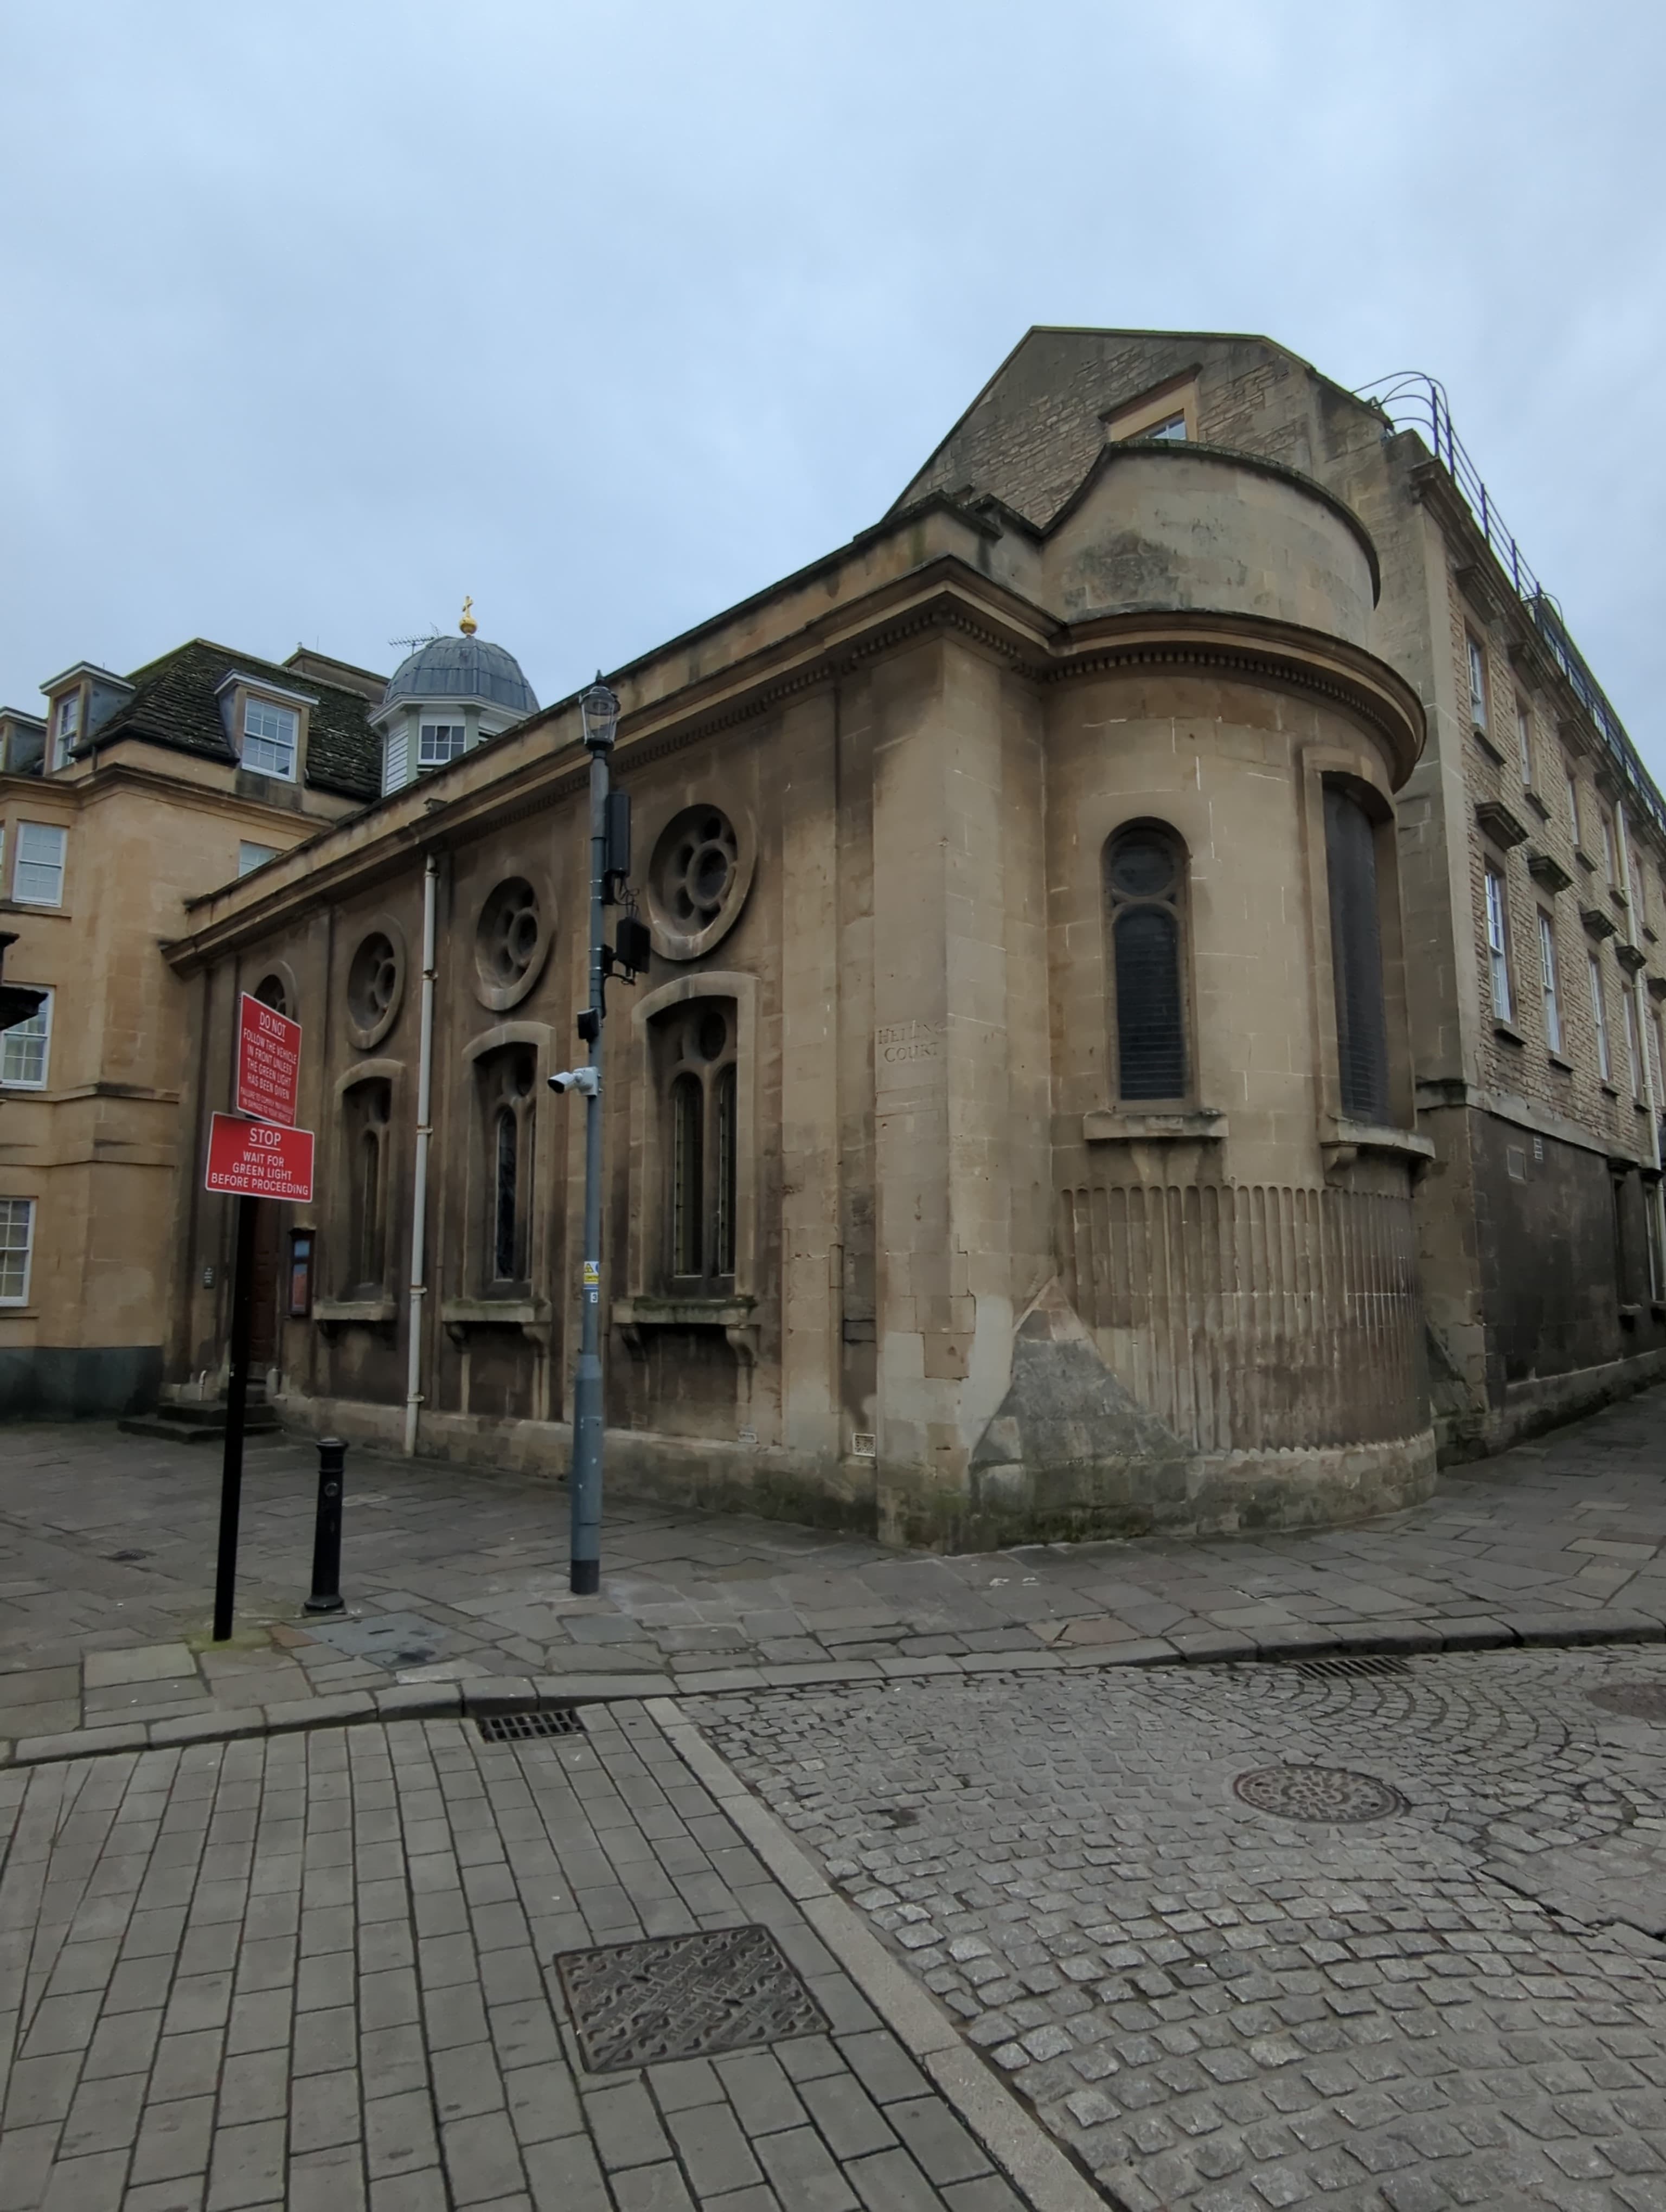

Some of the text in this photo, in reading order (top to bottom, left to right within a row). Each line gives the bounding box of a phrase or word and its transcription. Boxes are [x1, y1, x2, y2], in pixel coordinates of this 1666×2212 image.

[260, 1012, 286, 1037] DO NOT
[244, 1027, 297, 1064] FOLLOW THE VEHICLE
[884, 1041, 940, 1063] COURT
[247, 1044, 292, 1075] IN FRONT UNLESS
[247, 1057, 291, 1087] THE GREEN LIGHT
[247, 1072, 290, 1100] HAS BEEN GIVEN
[249, 1128, 281, 1146] STOP
[243, 1150, 285, 1167] WAIT FOR
[232, 1162, 292, 1181] GREEN LIGHT
[211, 1173, 309, 1195] BEFORE PROCEEDING
